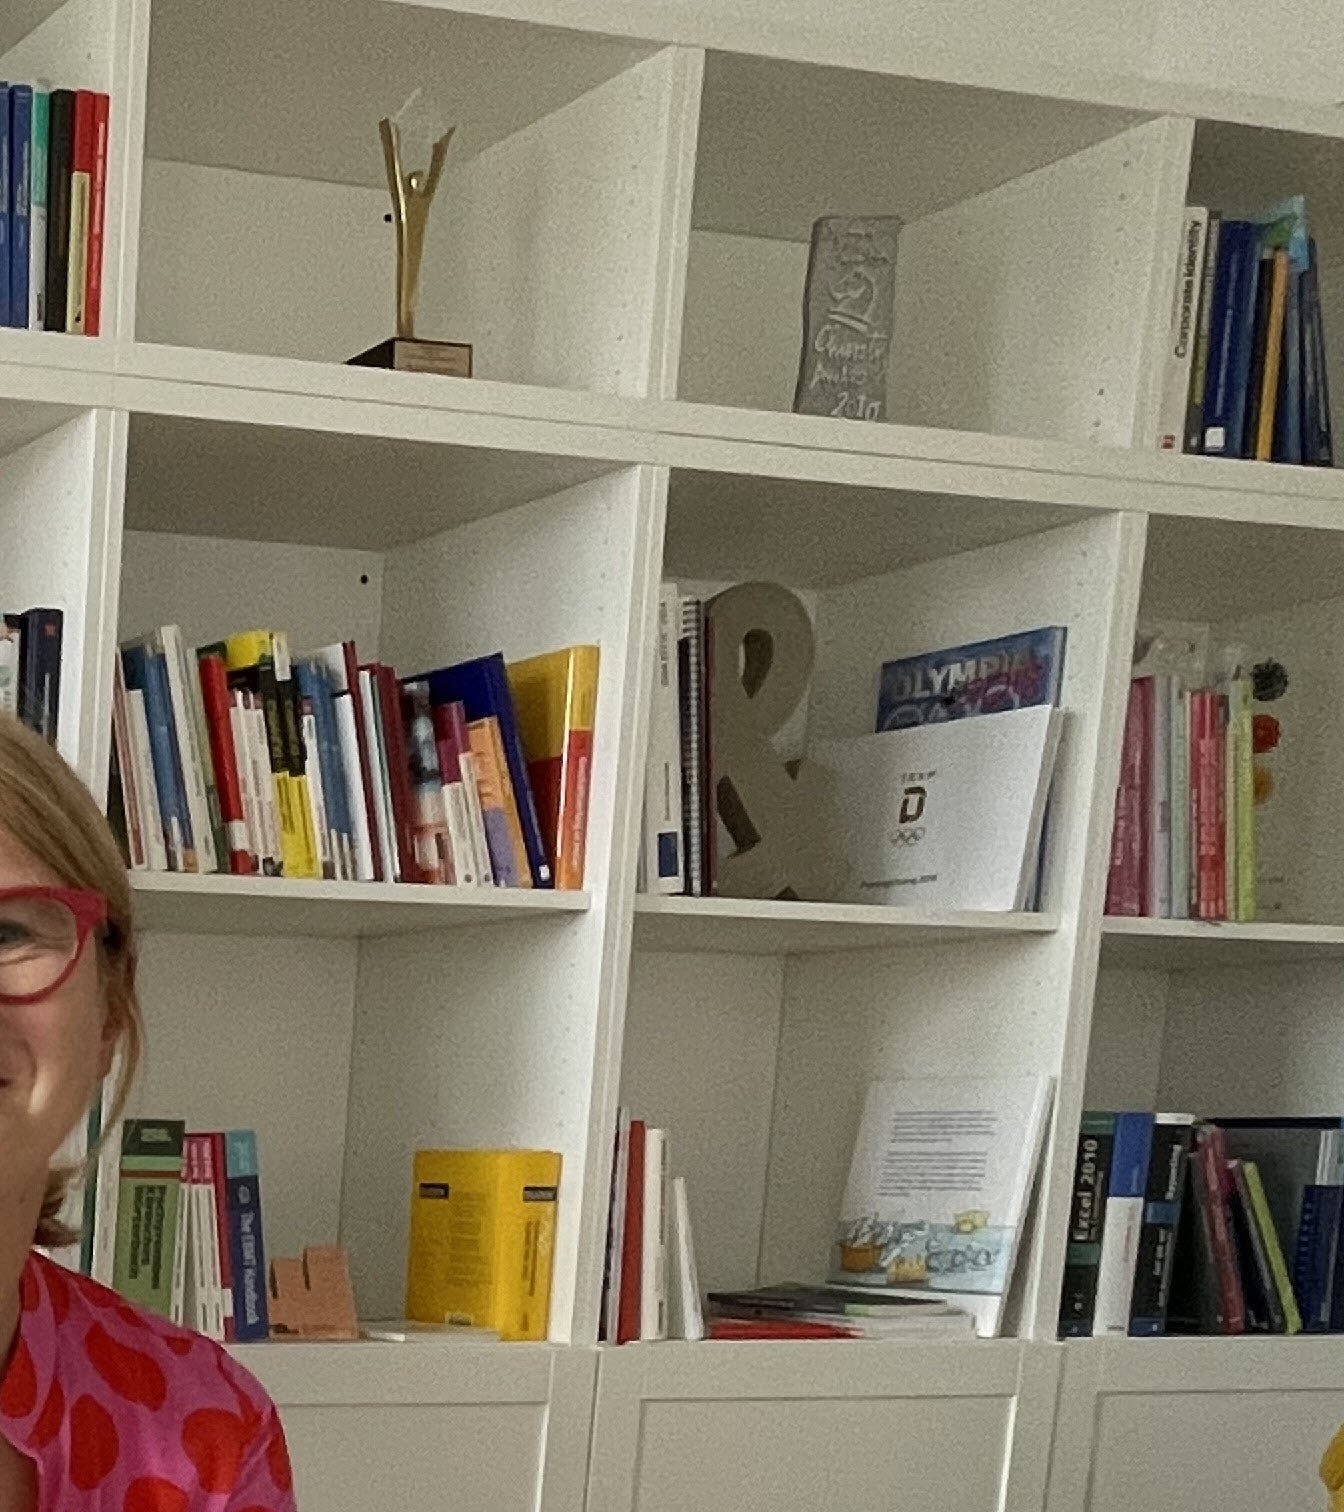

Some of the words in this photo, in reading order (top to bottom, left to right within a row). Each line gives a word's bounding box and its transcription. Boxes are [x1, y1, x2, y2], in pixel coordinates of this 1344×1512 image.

[1184, 219, 1204, 279] Identity
[893, 652, 1034, 701] OLYMPIA
[898, 785, 928, 824] D
[1080, 1139, 1100, 1185] 2010
[1071, 1191, 1092, 1242] Excel
